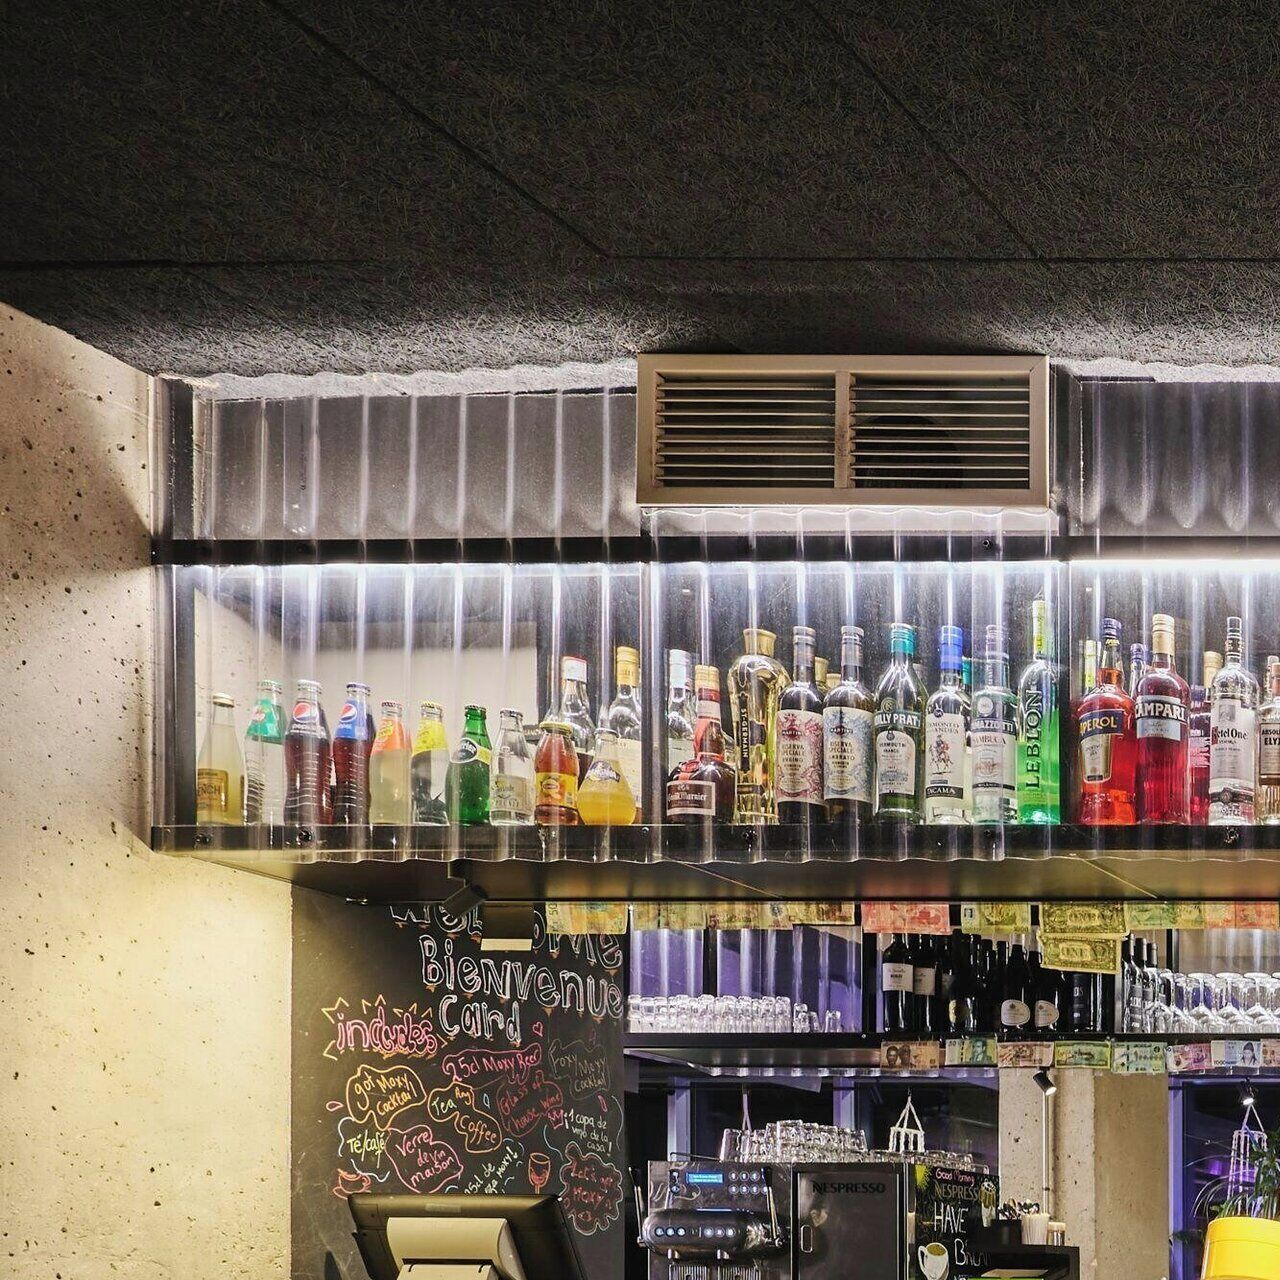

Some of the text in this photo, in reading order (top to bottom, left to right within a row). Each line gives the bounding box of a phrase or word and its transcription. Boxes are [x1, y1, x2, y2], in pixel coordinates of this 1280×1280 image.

[1135, 703, 1185, 720] CAMPARI
[740, 708, 749, 759] ST-GERMAIN
[1026, 690, 1042, 789] LEBLON
[1231, 728, 1247, 740] One
[419, 934, 624, 1019] Bienvenue
[337, 1006, 437, 1054] includes
[482, 1056, 515, 1079] Moxy
[376, 1073, 411, 1093] Moxy
[431, 1097, 457, 1116] Tea
[460, 1115, 497, 1144] Coffee
[395, 1131, 430, 1157] Verre
[936, 1167, 953, 1181] Good
[813, 1181, 886, 1195] NESPRESSO
[934, 1201, 969, 1234] HAVE
